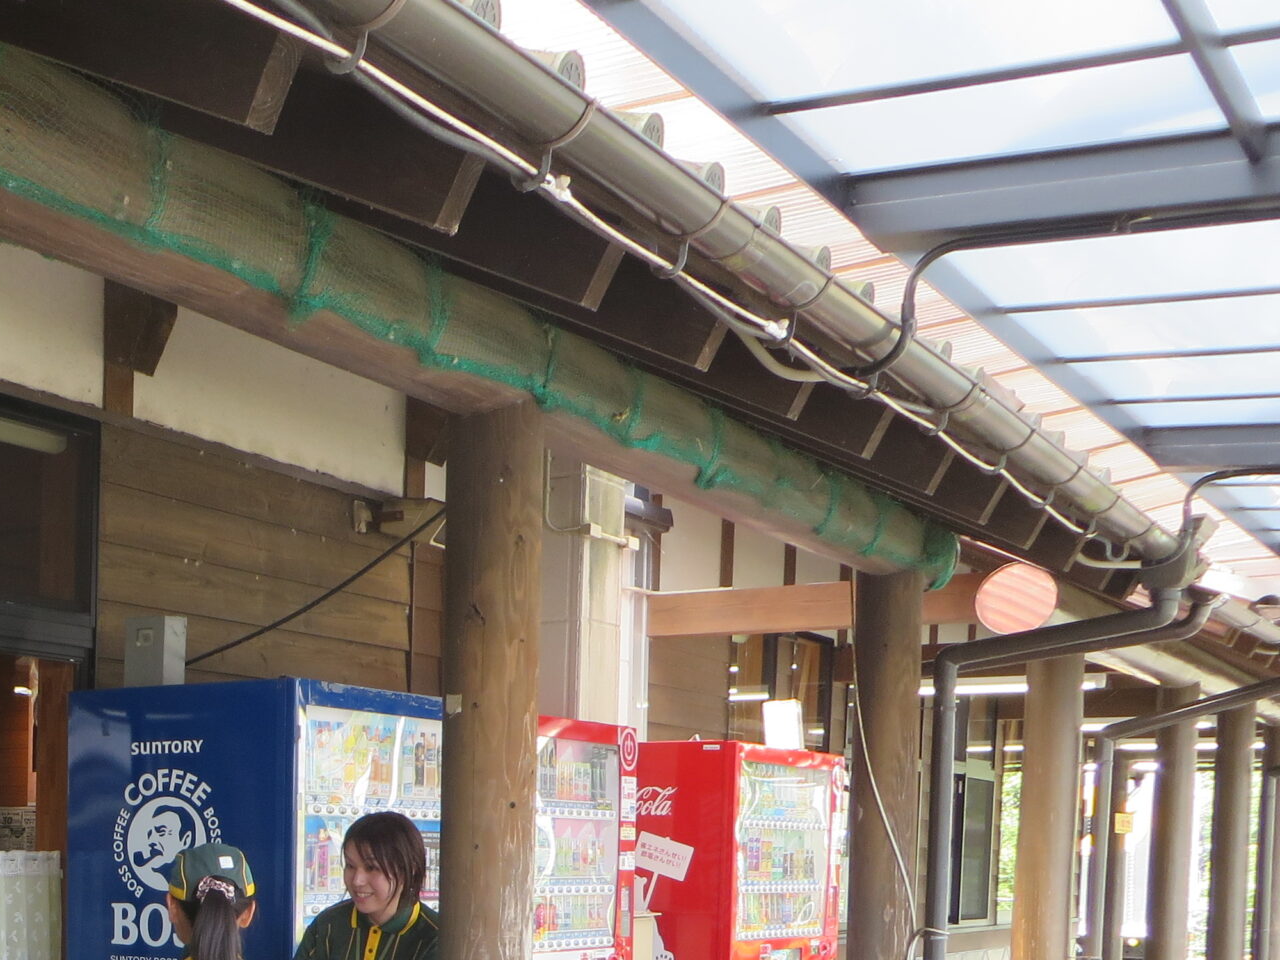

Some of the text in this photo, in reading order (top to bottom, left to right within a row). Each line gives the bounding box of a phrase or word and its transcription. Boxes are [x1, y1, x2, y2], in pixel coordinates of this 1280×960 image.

[131, 740, 203, 755] SUNTORY
[124, 769, 212, 807] COFFEE
[113, 808, 144, 898] BOSS COFFEE
[111, 903, 184, 948] BO
